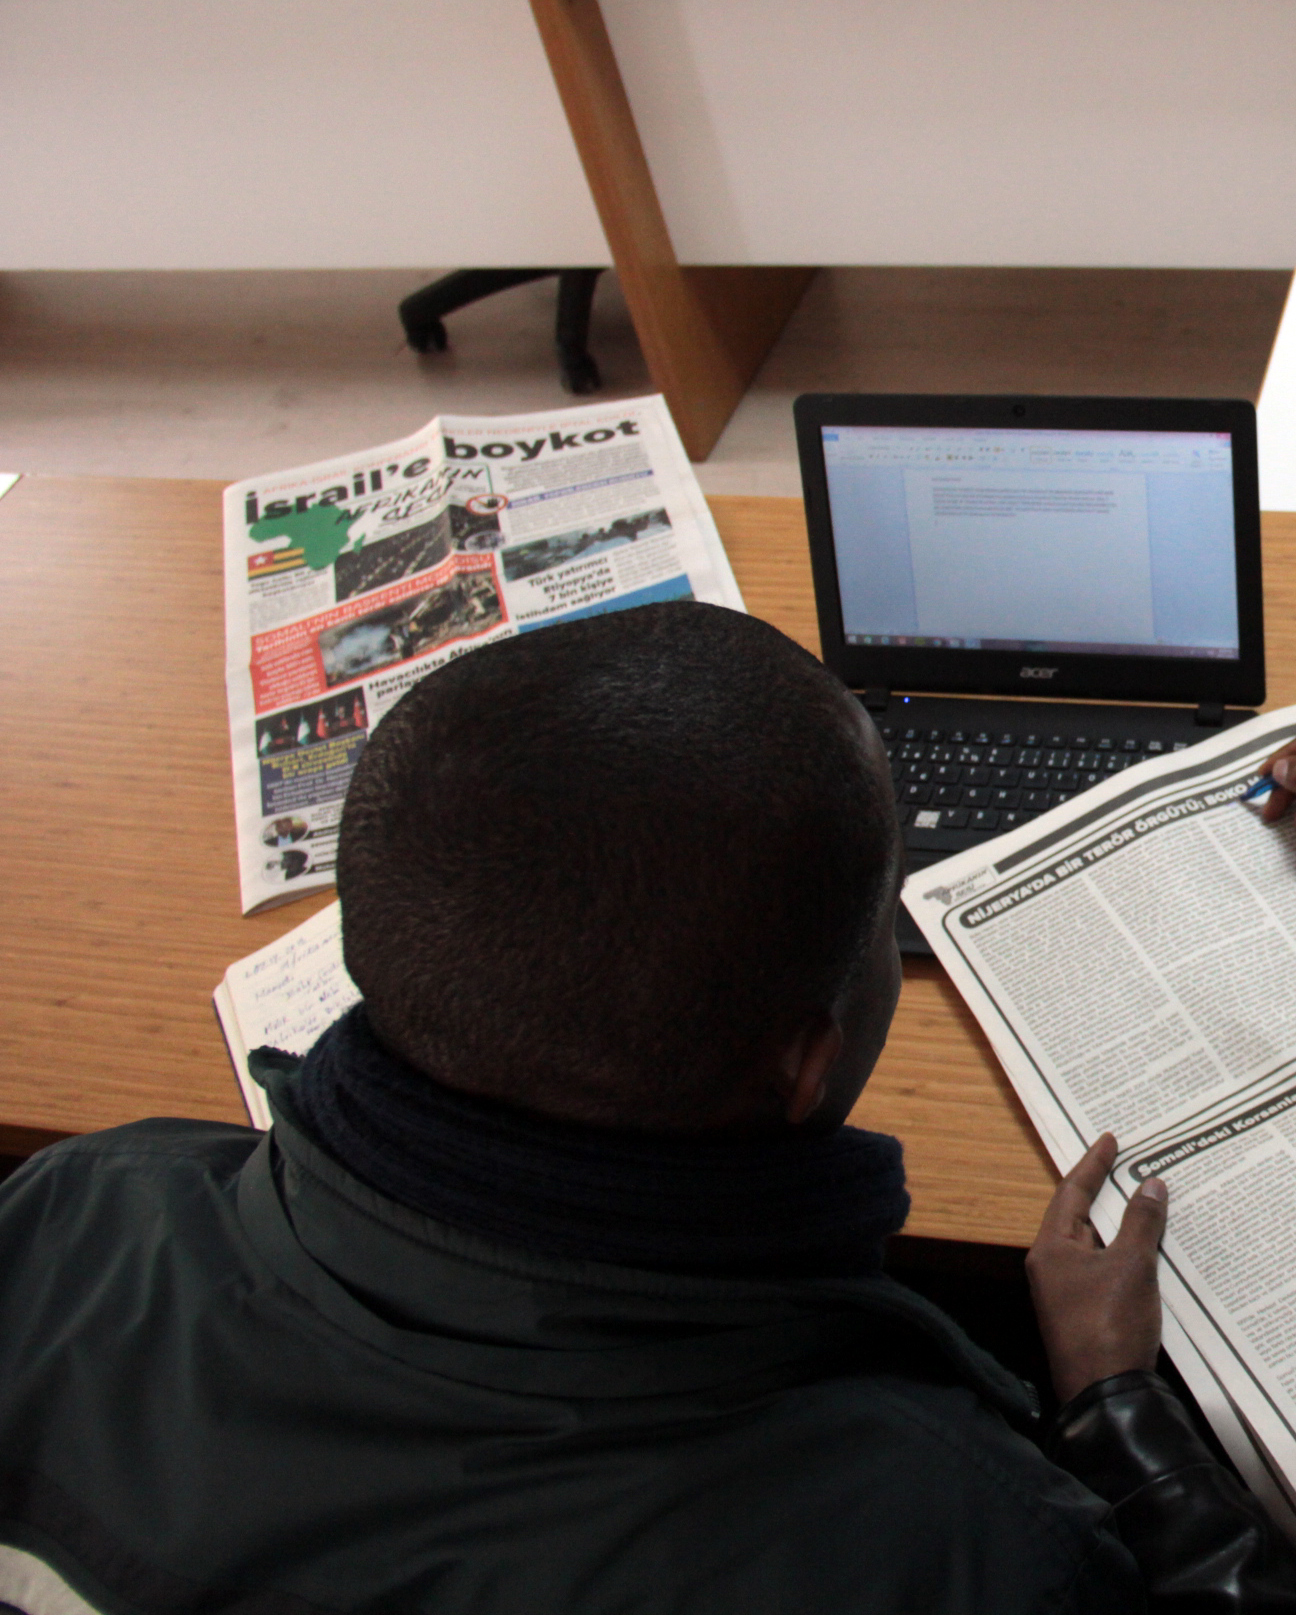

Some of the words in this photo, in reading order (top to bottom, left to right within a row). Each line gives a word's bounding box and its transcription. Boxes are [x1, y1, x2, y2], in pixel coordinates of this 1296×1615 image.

[442, 419, 641, 462] boykot
[528, 574, 555, 588] Türk
[559, 587, 578, 600] bin
[1019, 665, 1059, 680] acer
[966, 872, 1057, 926] NİJERYA'DA
[1054, 855, 1086, 879] BİR
[1083, 826, 1136, 862] TERÖR
[1204, 783, 1249, 806] BOKO
[1136, 1126, 1233, 1178] Somali'deki
